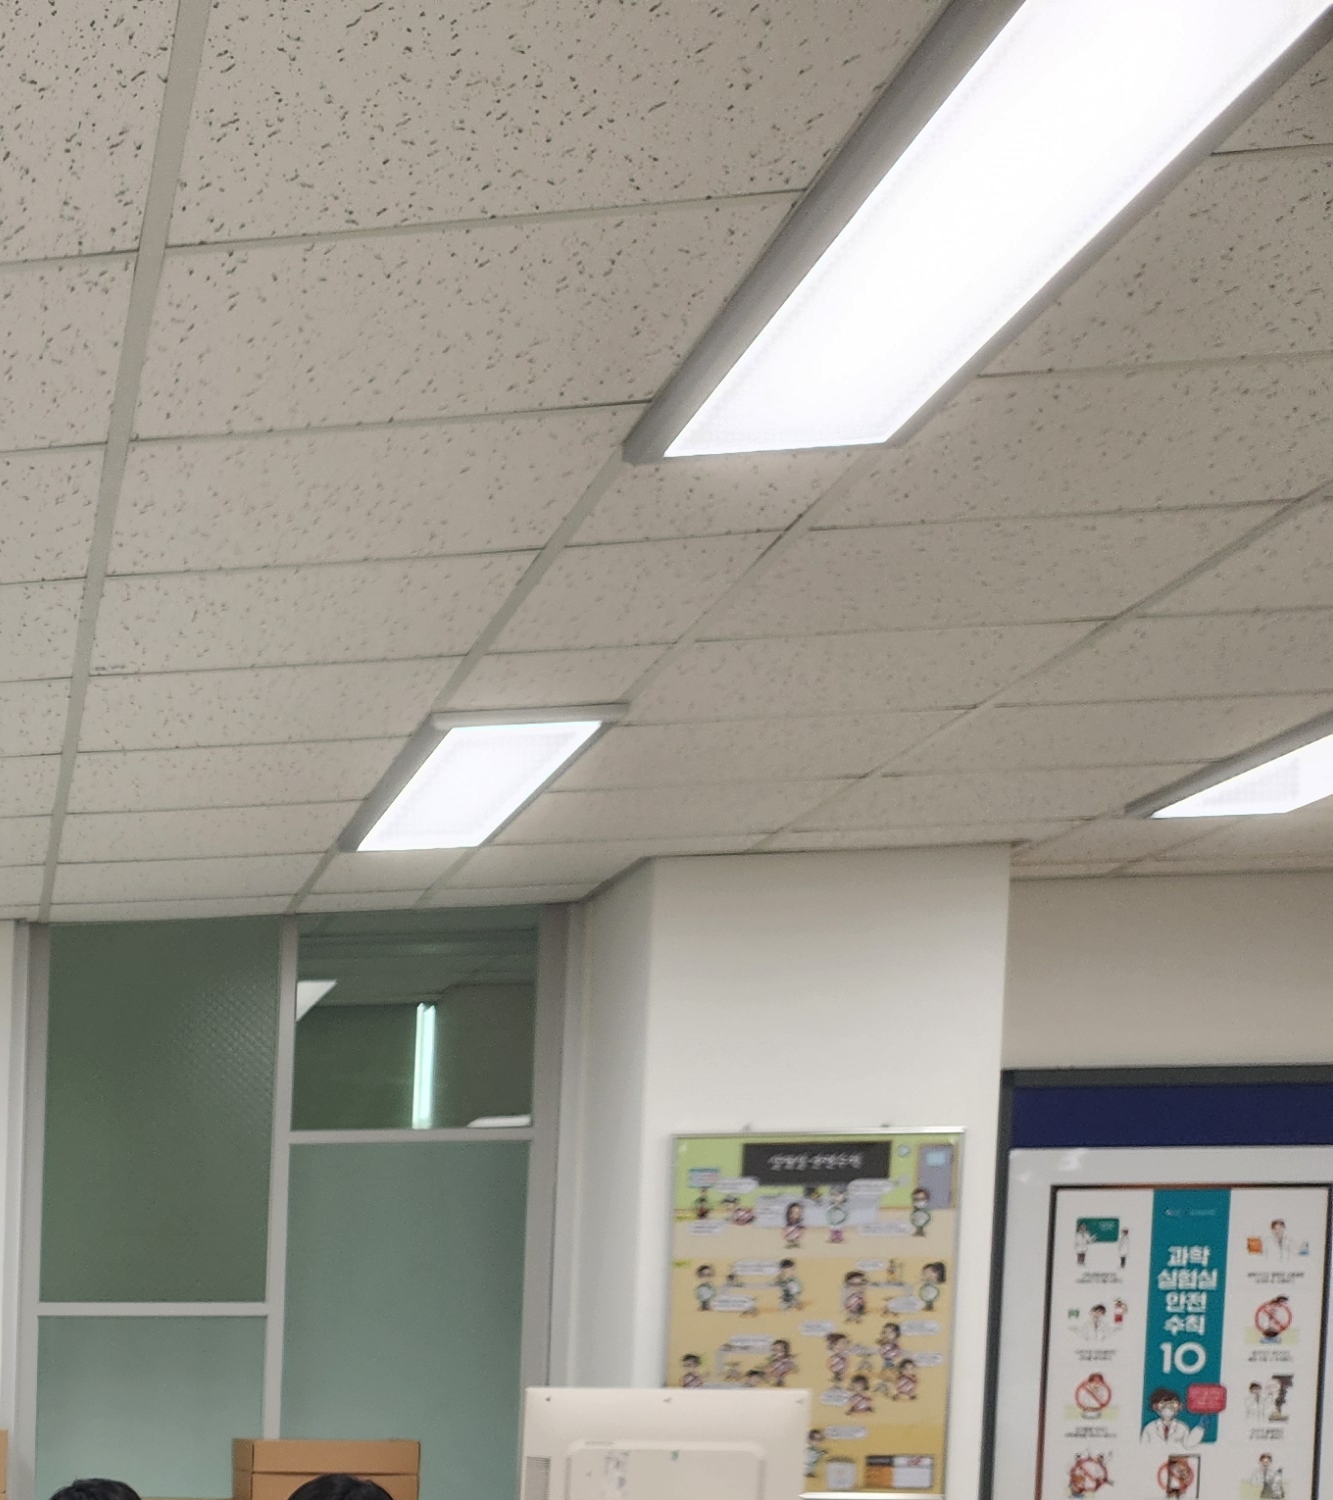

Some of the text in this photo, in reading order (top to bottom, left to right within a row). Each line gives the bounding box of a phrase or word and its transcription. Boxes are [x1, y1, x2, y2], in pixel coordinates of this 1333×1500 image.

[1167, 1245, 1211, 1267] 과학
[1157, 1268, 1219, 1291] 실험실
[1165, 1291, 1208, 1313] 안전
[1163, 1314, 1206, 1336] 수칙
[1160, 1341, 1207, 1375] 10
